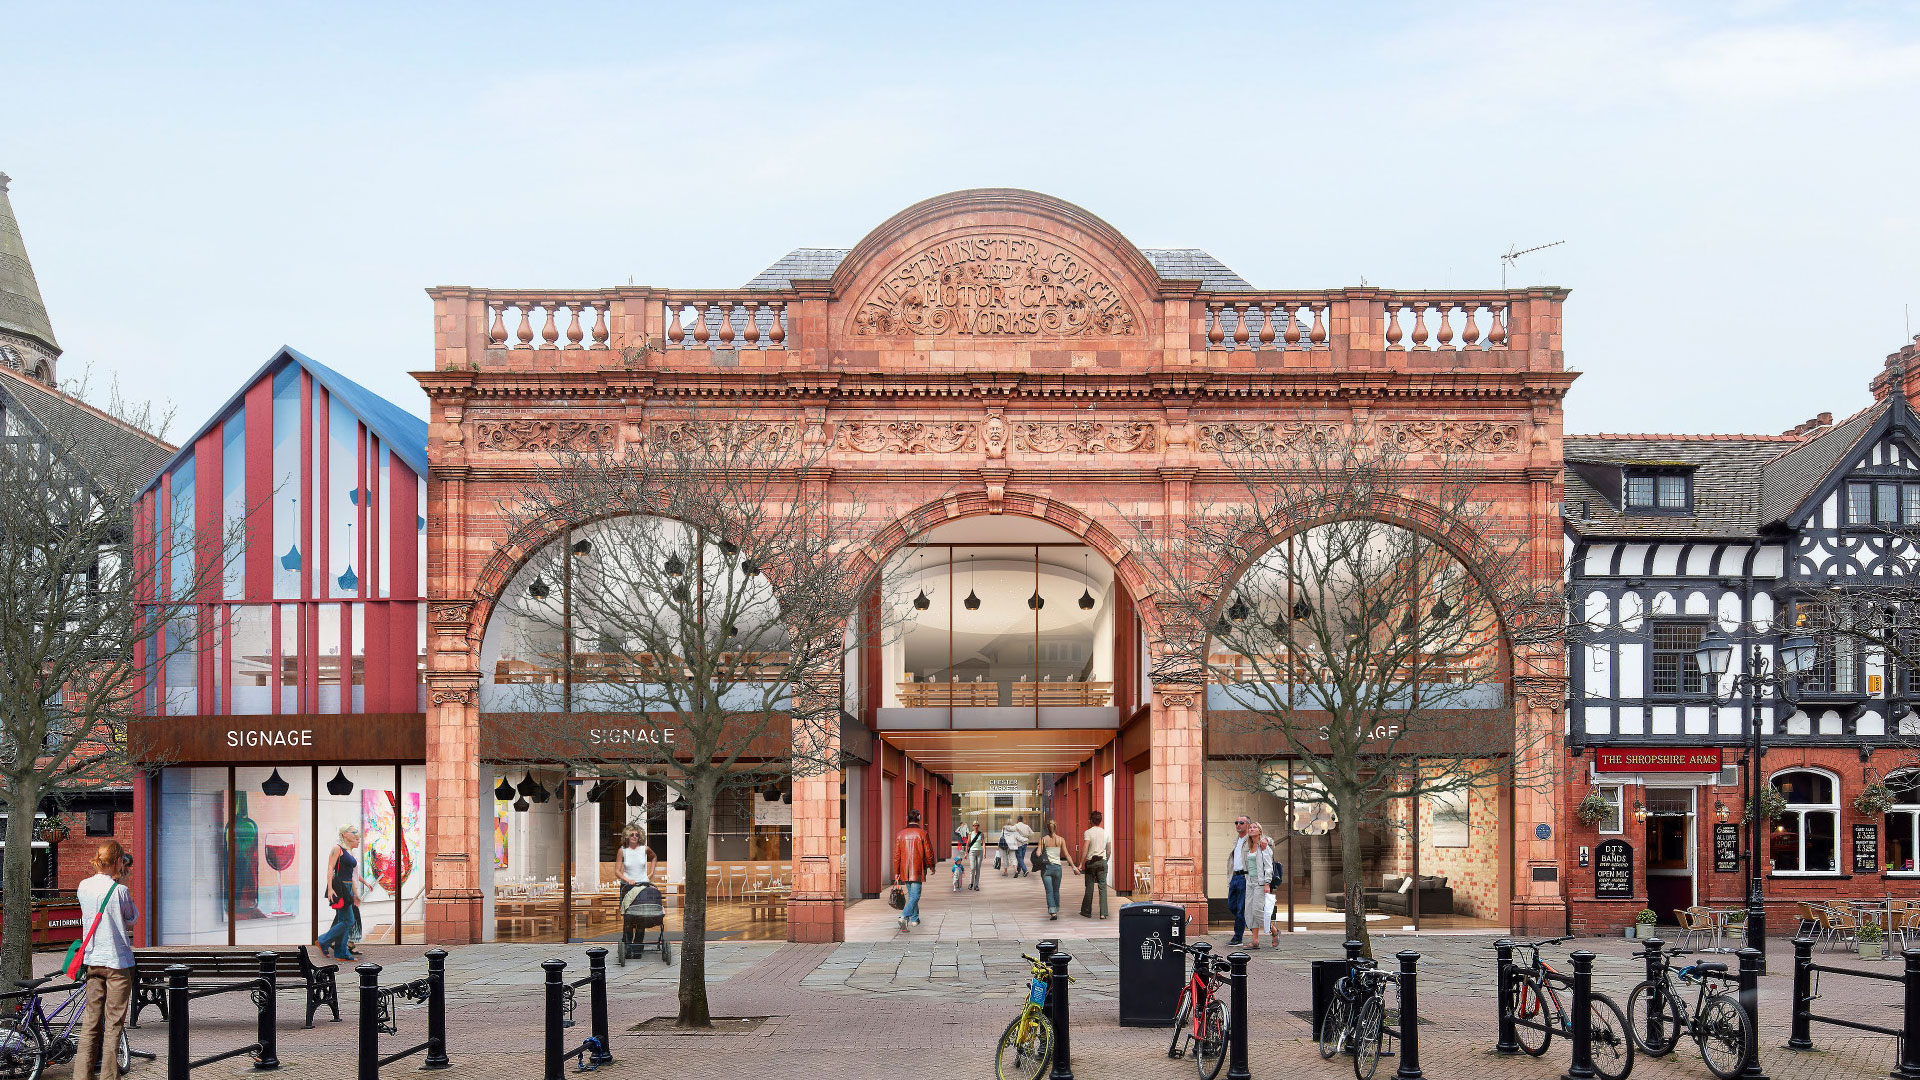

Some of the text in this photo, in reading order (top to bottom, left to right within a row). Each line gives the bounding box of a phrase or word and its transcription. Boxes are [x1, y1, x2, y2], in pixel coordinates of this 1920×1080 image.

[867, 239, 1120, 313] WESTMINSTER COACH
[974, 265, 1013, 280] AND
[922, 283, 1071, 308] MOTOR CAR
[952, 310, 1040, 334] WORKS
[227, 730, 312, 747] SIGNAGE
[590, 728, 675, 744] SIGNAGE
[1602, 755, 1717, 764] THE SHROPSHIRE ARMS
